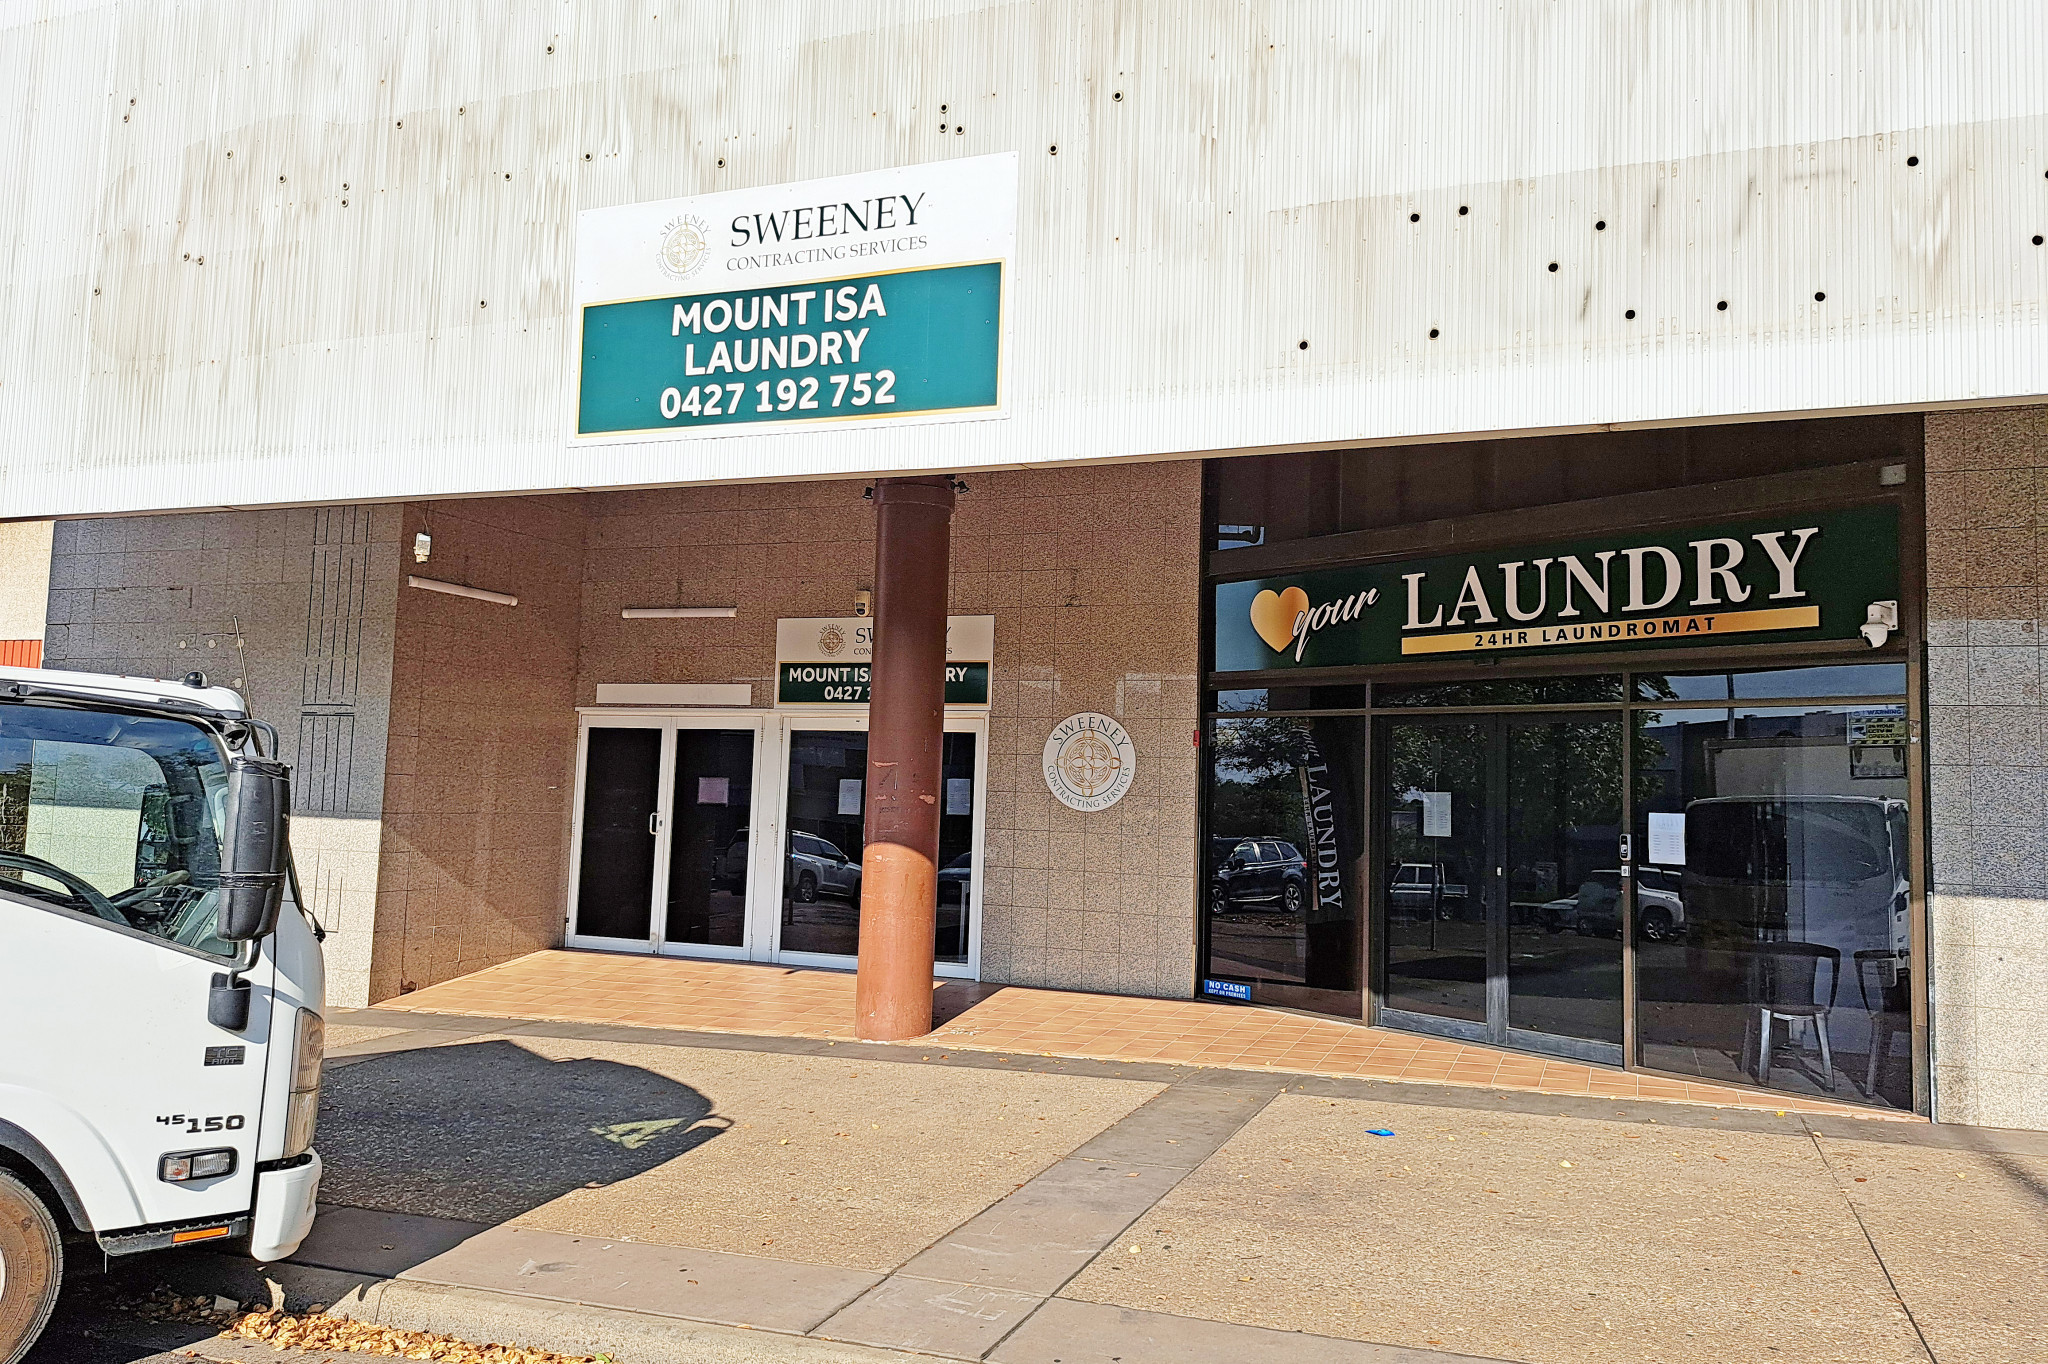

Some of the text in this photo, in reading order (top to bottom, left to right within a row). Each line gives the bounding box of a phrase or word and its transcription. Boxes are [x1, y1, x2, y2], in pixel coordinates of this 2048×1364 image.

[660, 213, 712, 237] SWEENEY
[730, 192, 926, 248] SWEENEY
[726, 235, 928, 272] CONTRACTING SERVICES
[671, 283, 887, 337] MOUNT ISA
[684, 327, 870, 377] LAUNDRY
[659, 369, 896, 419] 0427 192 752
[1292, 527, 1820, 663] your LAUNDRY
[1474, 616, 1716, 648] 24HR LAUNDROMAT
[788, 667, 872, 682] MOUNT IS
[824, 685, 863, 700] 0427
[1053, 716, 1129, 746] SWEENEY
[1047, 765, 1131, 809] CONTRACTING SERVICES
[1307, 762, 1343, 909] LAUNDRY
[1208, 981, 1246, 994] NO CASH
[186, 1114, 246, 1134] 150
